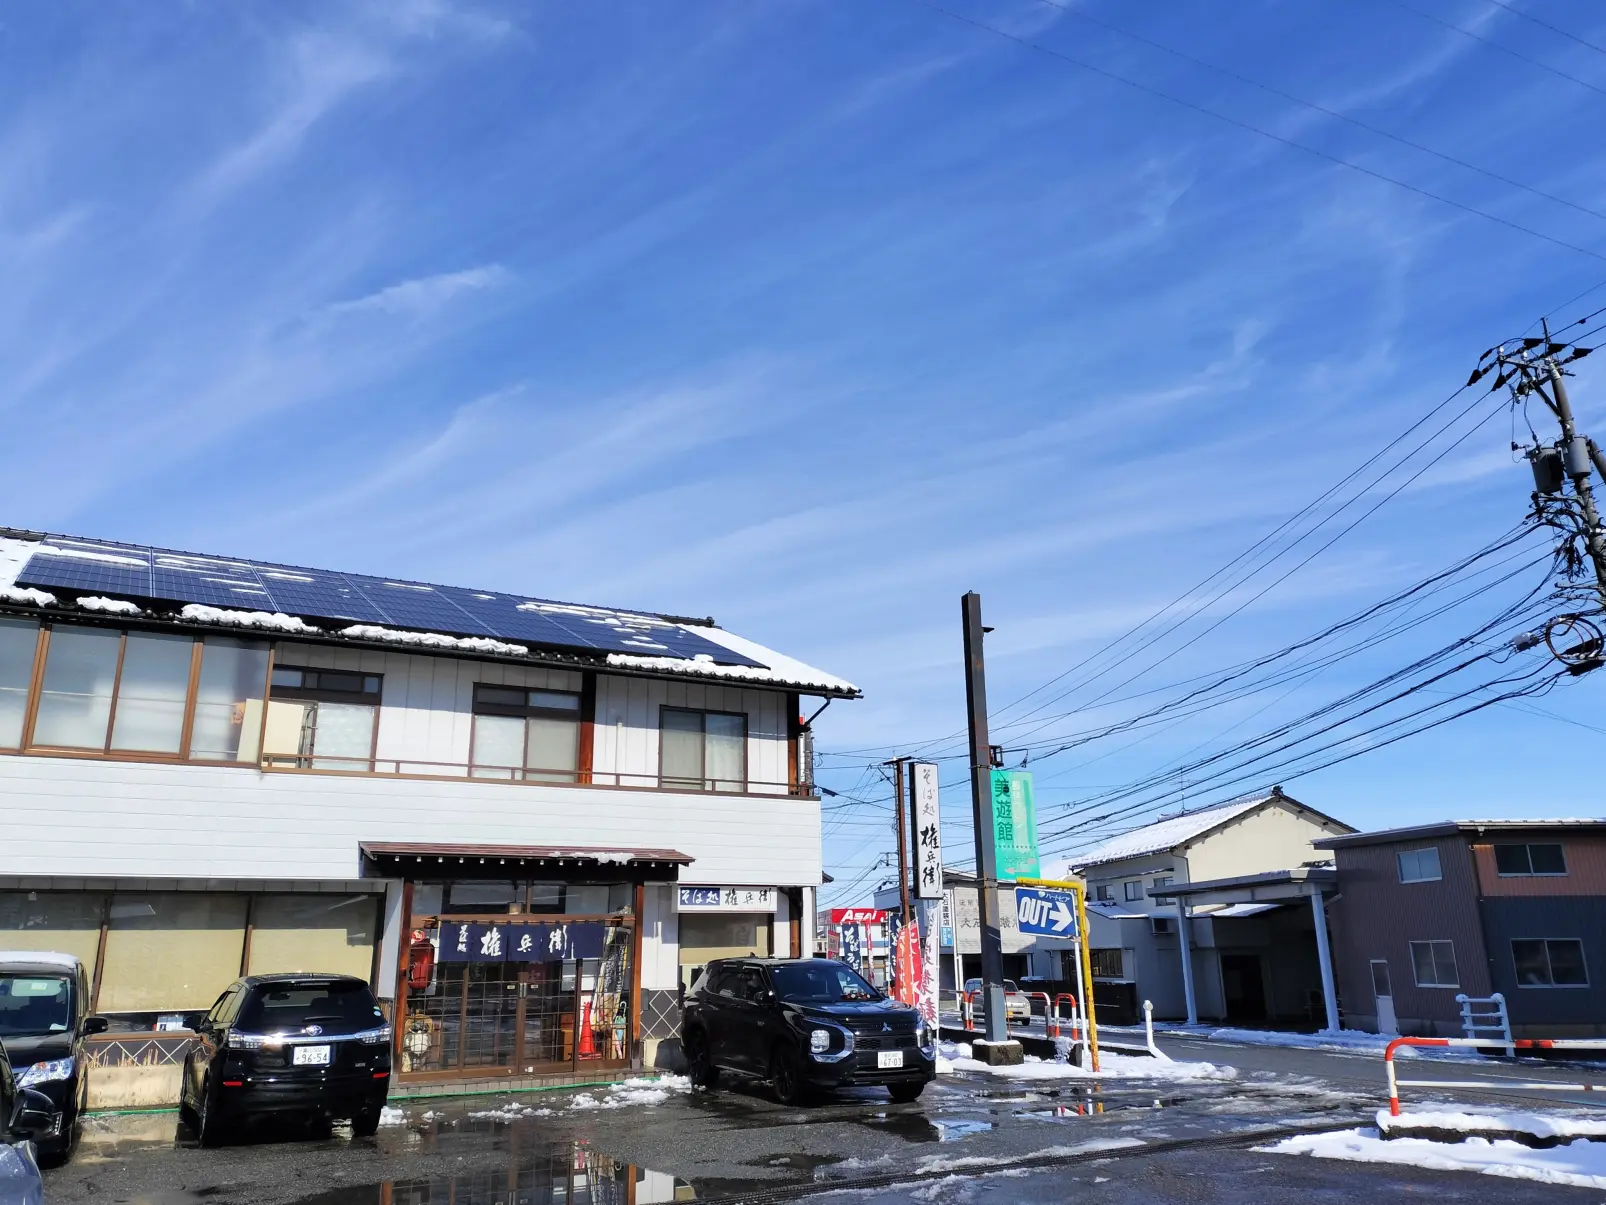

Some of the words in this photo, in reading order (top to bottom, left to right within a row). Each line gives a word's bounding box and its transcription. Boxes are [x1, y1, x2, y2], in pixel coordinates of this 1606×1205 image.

[922, 768, 936, 816] そば処
[995, 779, 1013, 841] 美遊館
[681, 889, 719, 904] そば処
[1019, 896, 1052, 928] OUT
[844, 926, 860, 972] そばうど
